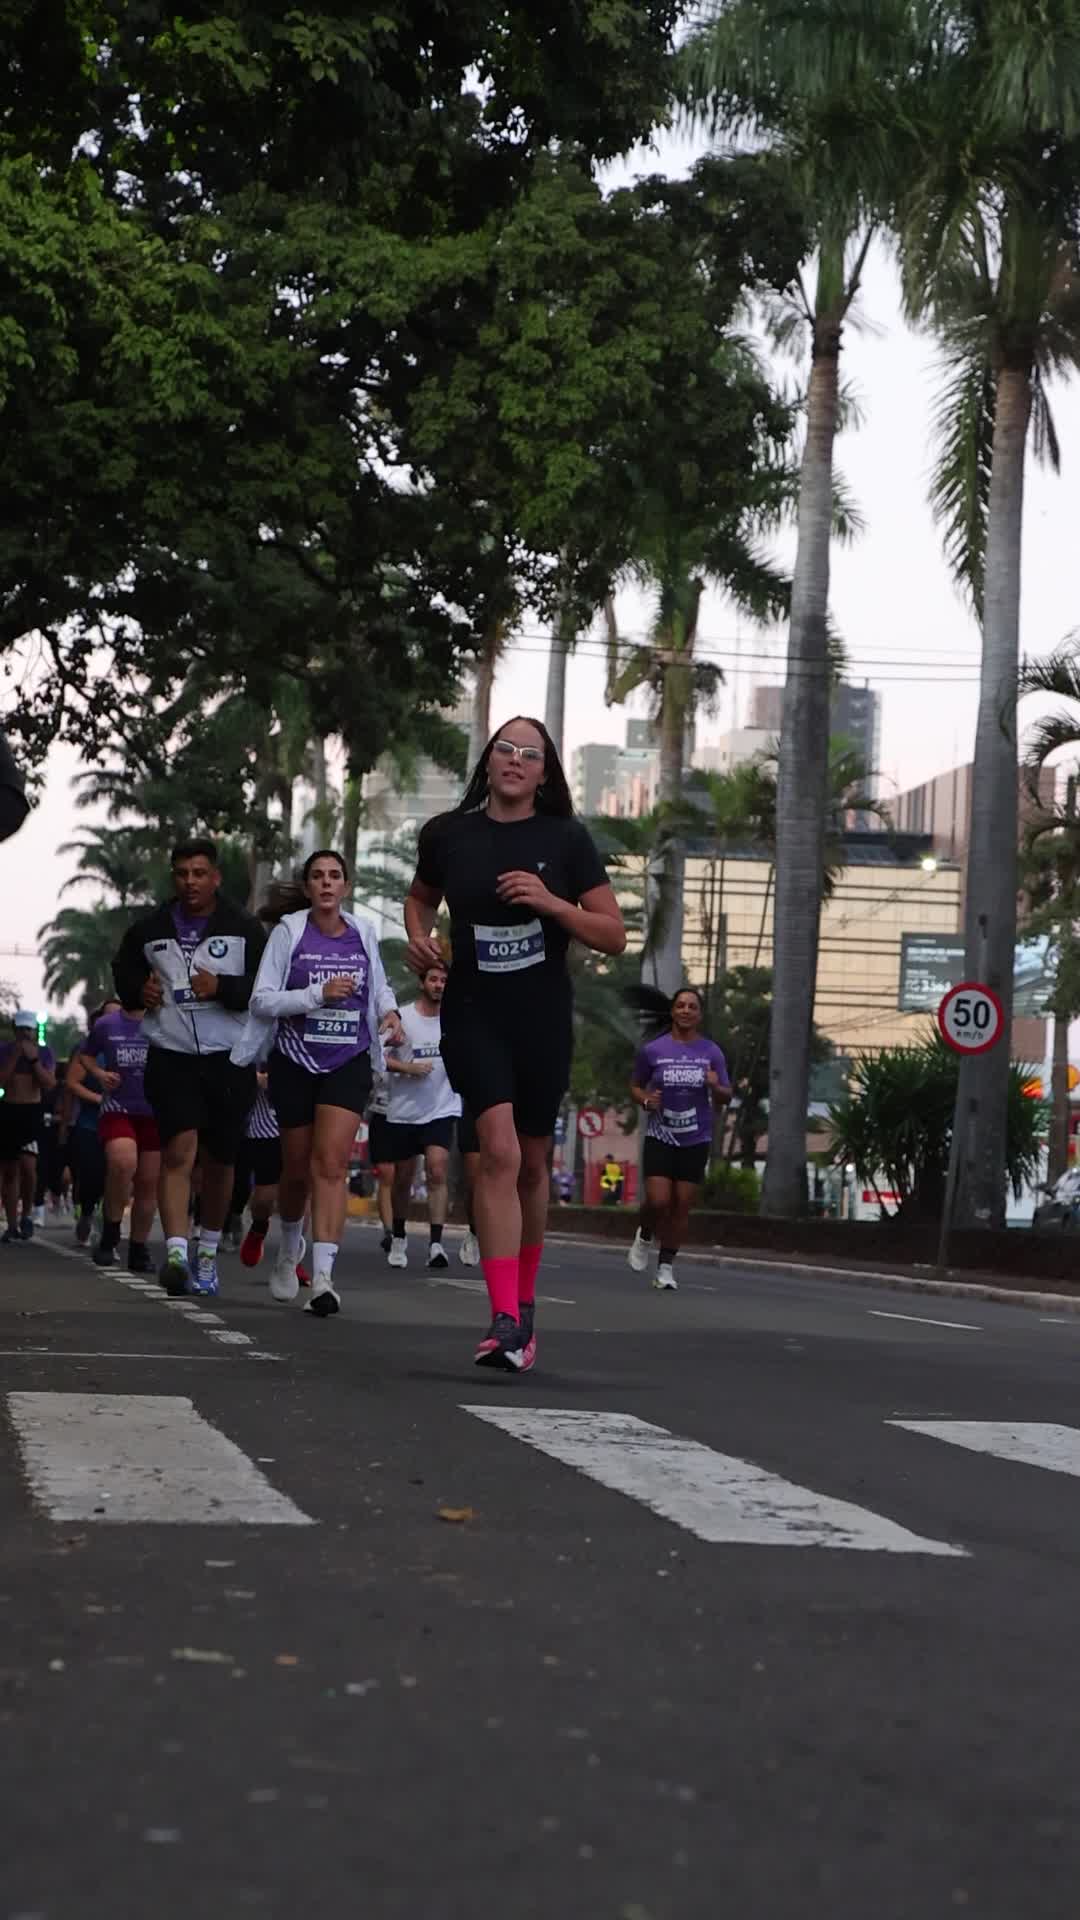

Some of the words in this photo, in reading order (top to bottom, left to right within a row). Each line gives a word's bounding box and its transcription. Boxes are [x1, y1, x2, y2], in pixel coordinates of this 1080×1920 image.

[489, 939, 530, 956] 6024
[953, 998, 991, 1029] 50
[317, 1021, 348, 1033] 5261
[956, 1031, 984, 1040] km/h
